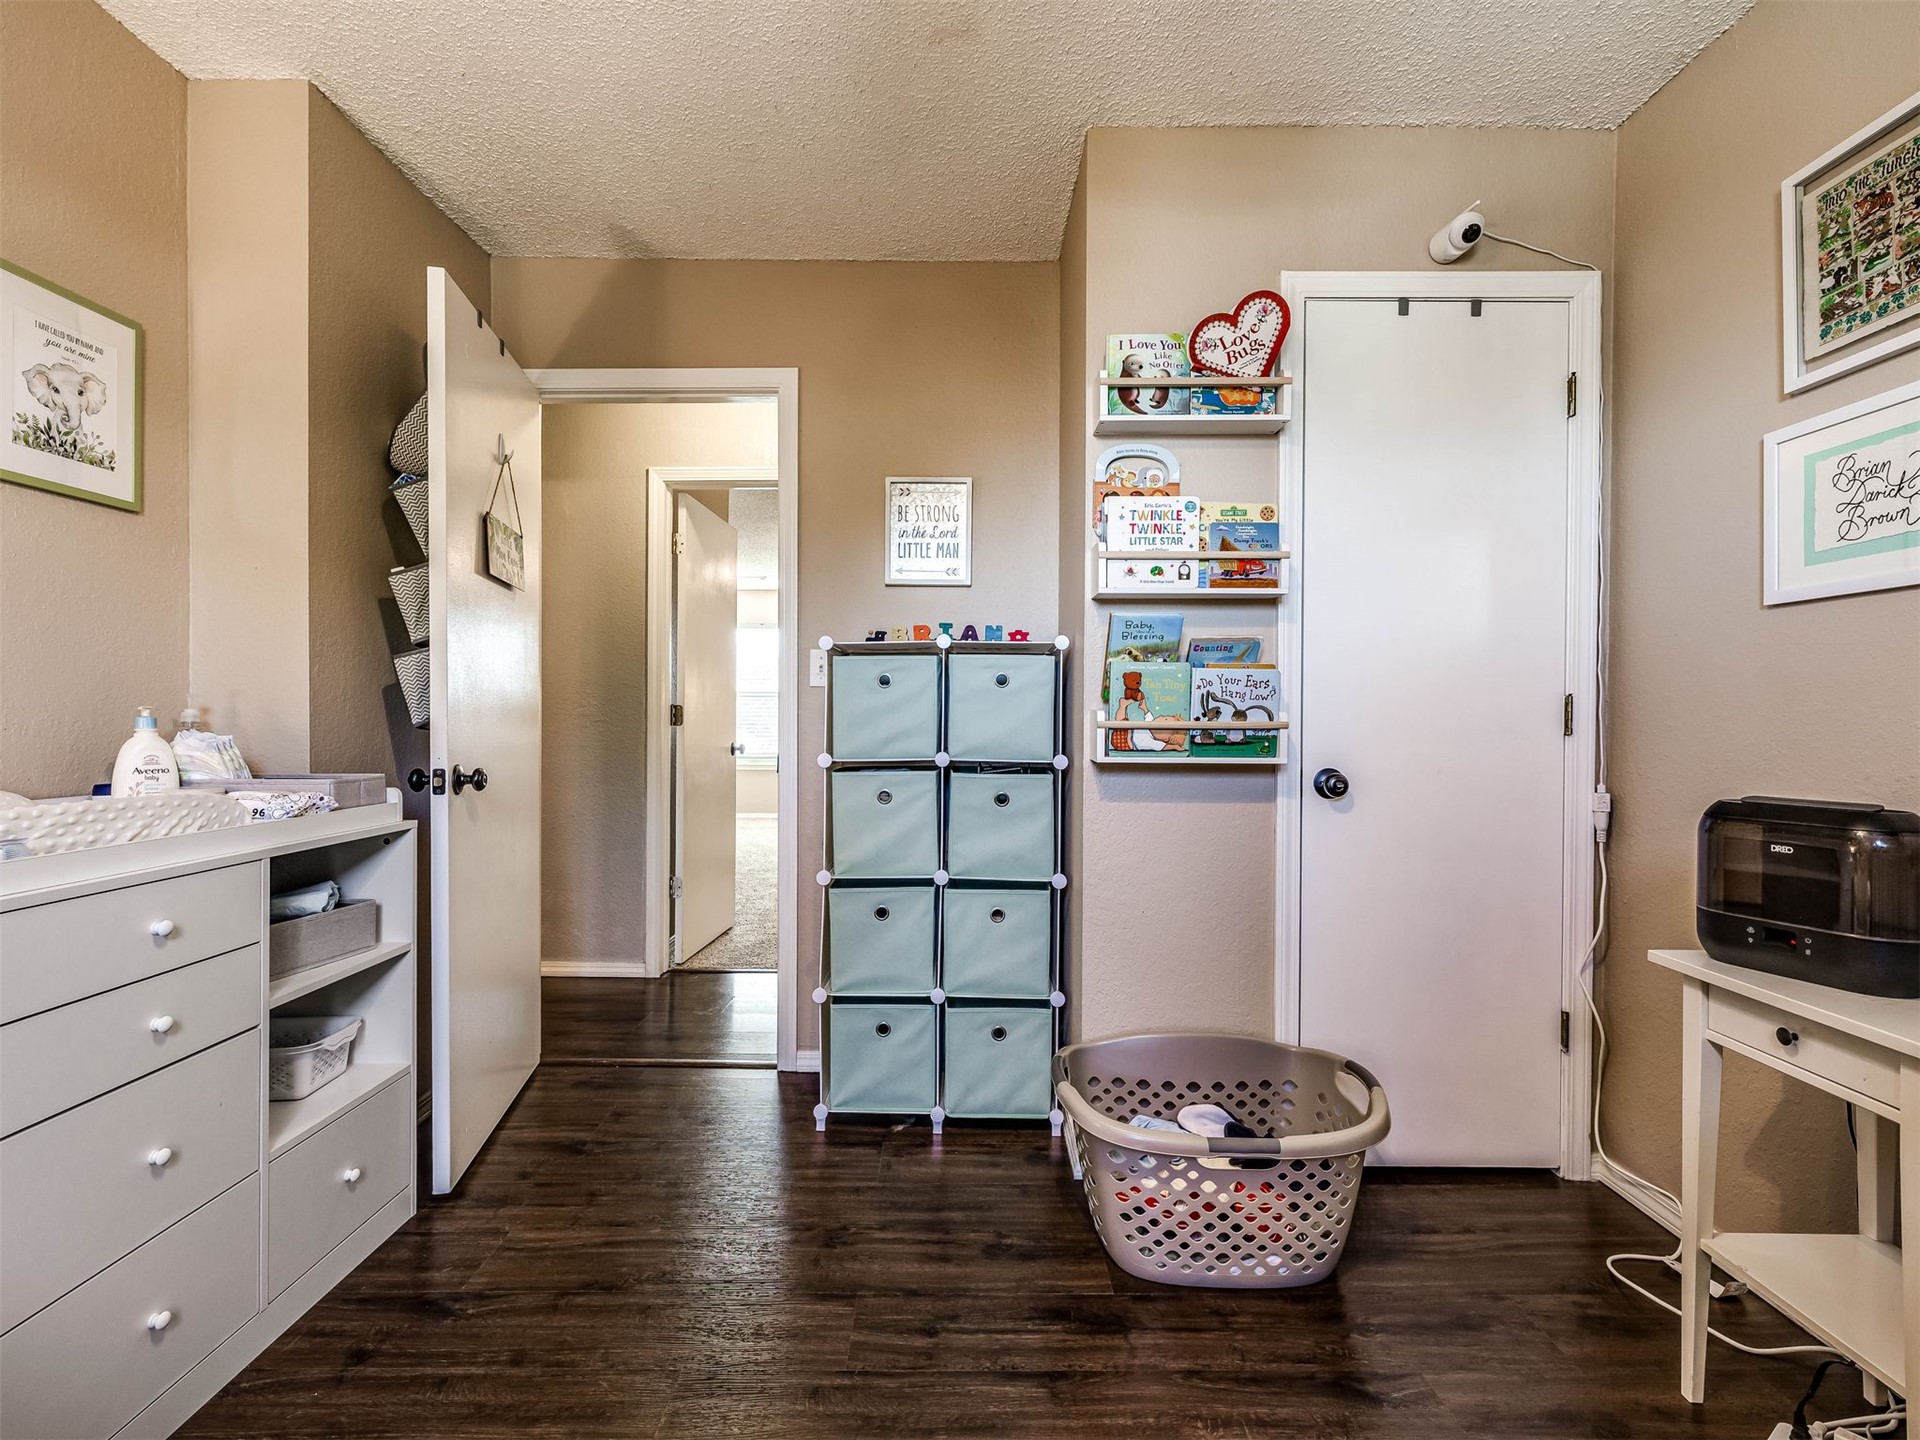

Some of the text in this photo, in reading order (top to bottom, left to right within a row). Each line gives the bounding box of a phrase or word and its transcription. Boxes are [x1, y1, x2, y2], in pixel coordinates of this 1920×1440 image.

[1823, 189, 1847, 211] INTO
[1854, 173, 1872, 193] THE
[38, 321, 50, 333] HAVE
[50, 326, 66, 340] CALLED
[66, 333, 75, 344] YOU
[75, 337, 80, 346] BY
[80, 339, 94, 352] NAME
[94, 346, 104, 356] AND
[1119, 339, 1182, 350] I Love You
[1218, 323, 1261, 352] Love
[43, 338, 62, 348] you
[63, 346, 77, 355] are
[77, 351, 96, 363] mine
[1154, 352, 1173, 360] Like
[1225, 338, 1266, 366] Bugs
[1162, 360, 1184, 369] Otter
[1832, 453, 1895, 492] Brian
[898, 504, 960, 522] BE STRONG
[1129, 510, 1186, 522] TWINKLE,
[1129, 524, 1186, 536] TWINKLE,
[1837, 505, 1917, 542] Brown
[898, 526, 958, 539] in the Lord
[1130, 536, 1183, 545] LITTLE STAR
[898, 543, 959, 558] LITTLE MAN
[1125, 620, 1155, 631] Baby,
[1122, 632, 1164, 642] Blessing
[1163, 678, 1186, 692] Tiny
[1200, 674, 1270, 689] Do Your Ears
[1220, 686, 1276, 702] Hang Low?
[252, 808, 265, 817] 96
[1770, 844, 1794, 854] DREO
